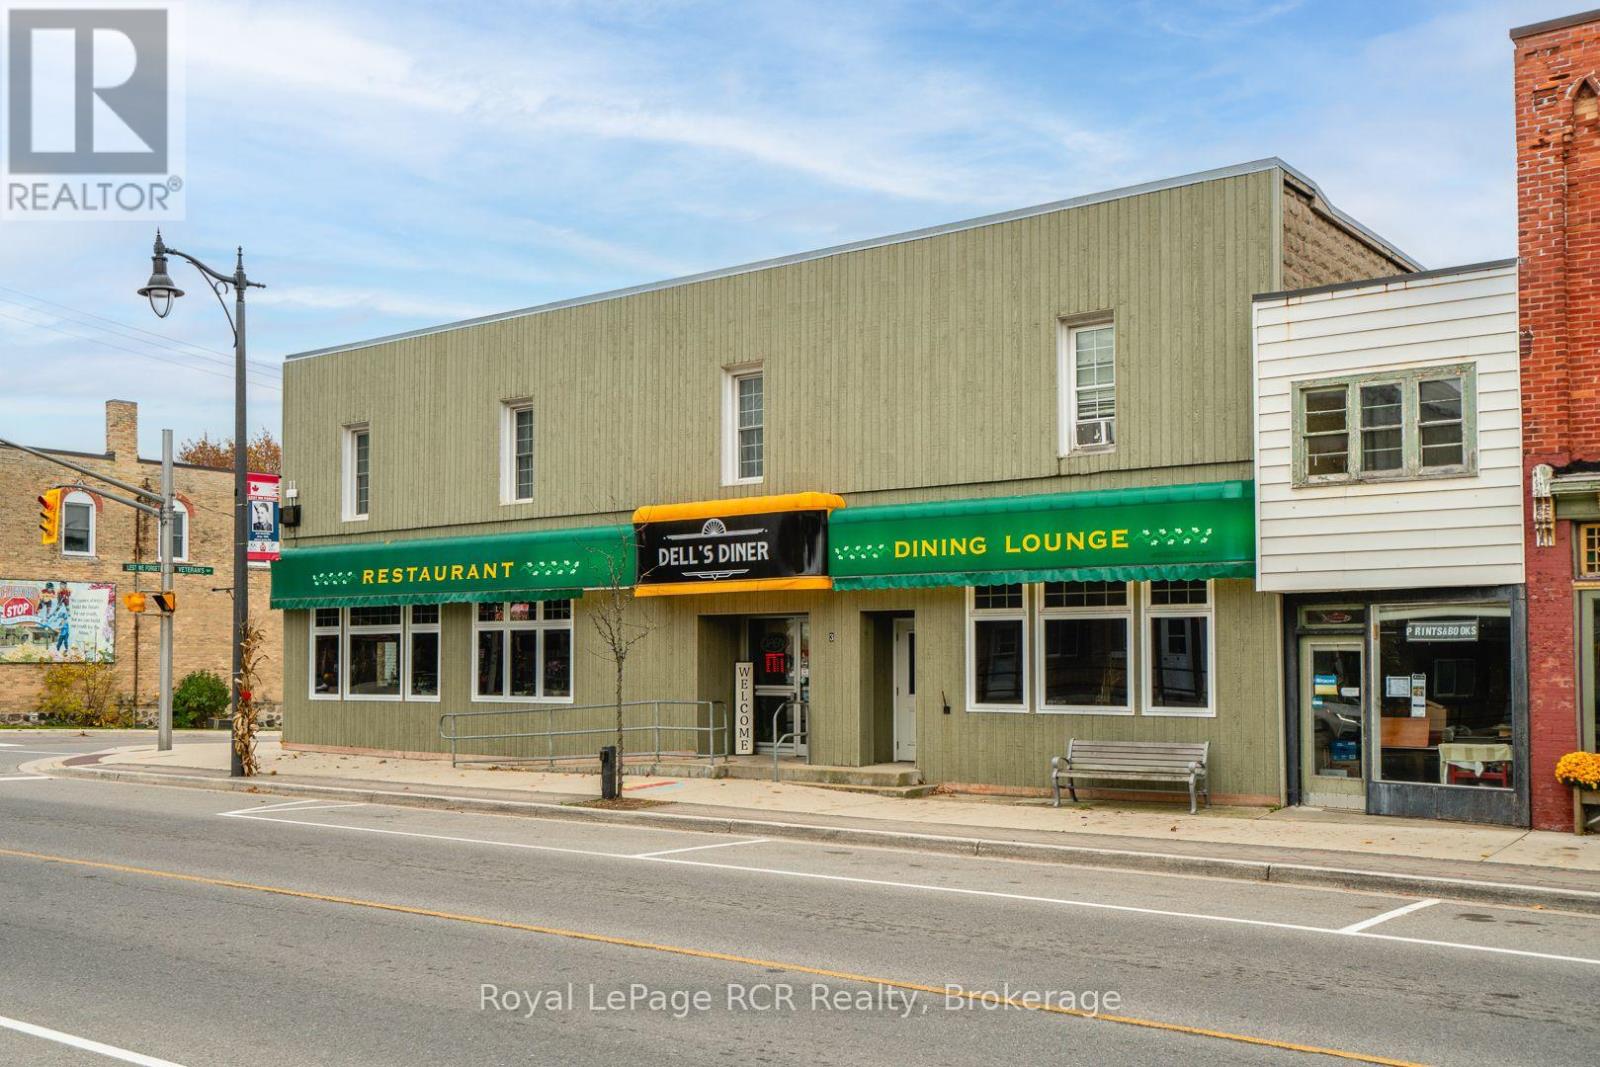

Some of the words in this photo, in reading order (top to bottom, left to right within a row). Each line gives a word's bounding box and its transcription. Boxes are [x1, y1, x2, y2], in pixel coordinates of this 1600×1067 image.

[658, 545, 713, 567] DELL'S
[718, 541, 769, 563] DINER
[894, 536, 987, 559] DINING
[1005, 528, 1129, 554] LOUNGE
[362, 562, 514, 584] RESTAURANT
[7, 603, 30, 617] STOP
[739, 667, 750, 751] WELCOME
